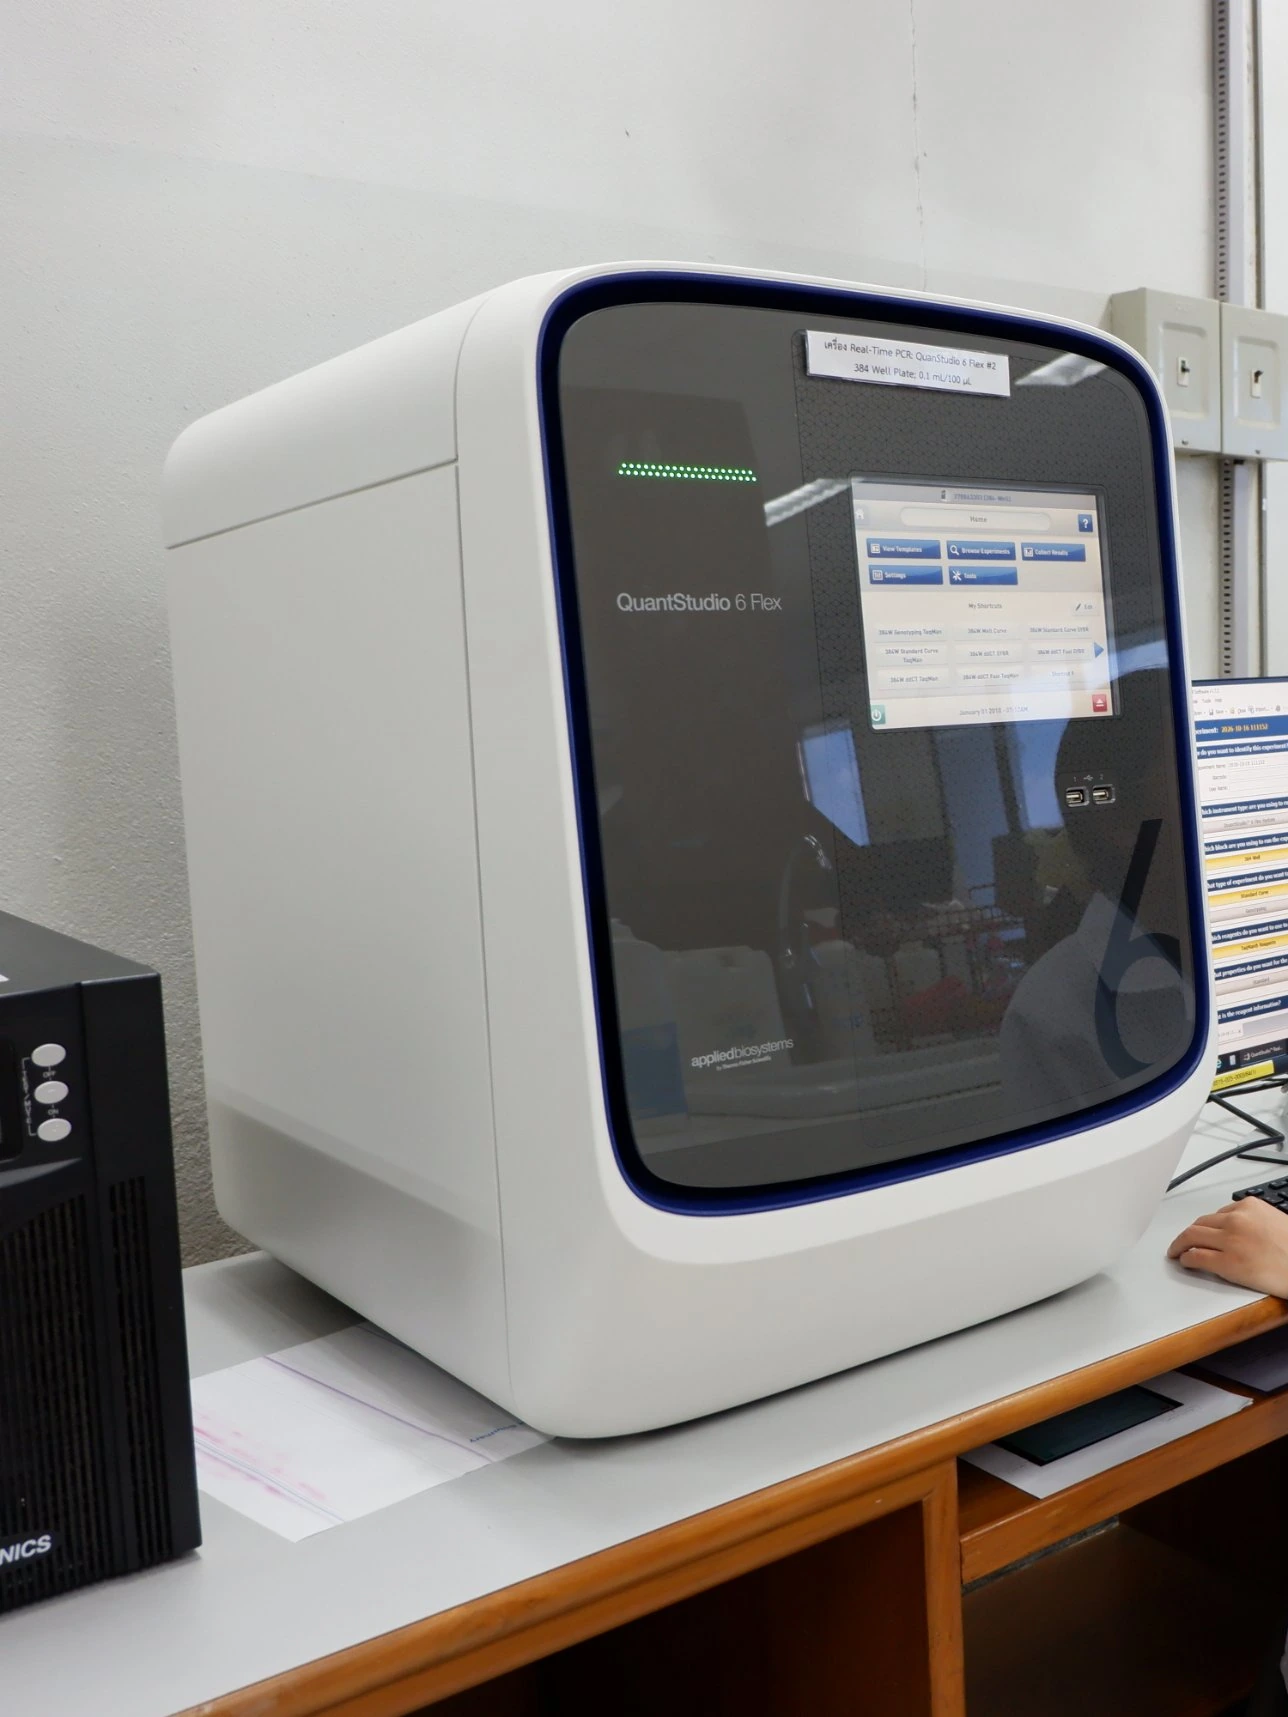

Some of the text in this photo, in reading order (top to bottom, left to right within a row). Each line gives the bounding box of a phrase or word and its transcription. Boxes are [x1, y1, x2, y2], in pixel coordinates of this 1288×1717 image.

[850, 344, 893, 356] Real-Time
[916, 352, 960, 366] QuanStudio
[969, 359, 984, 368] Flex
[986, 362, 996, 370] #2
[854, 364, 868, 372] 384
[872, 366, 891, 376] Well
[616, 592, 782, 612] QuantStudio 6 Flex
[1262, 744, 1288, 752] experiment?
[1232, 876, 1258, 886] experiment
[1222, 931, 1241, 940] reagents
[1222, 966, 1246, 977] properties
[1235, 1006, 1252, 1016] reagent
[1254, 1000, 1282, 1011] information?
[691, 1038, 794, 1068] appliedbiosystems
[0, 1534, 52, 1567] NICS
